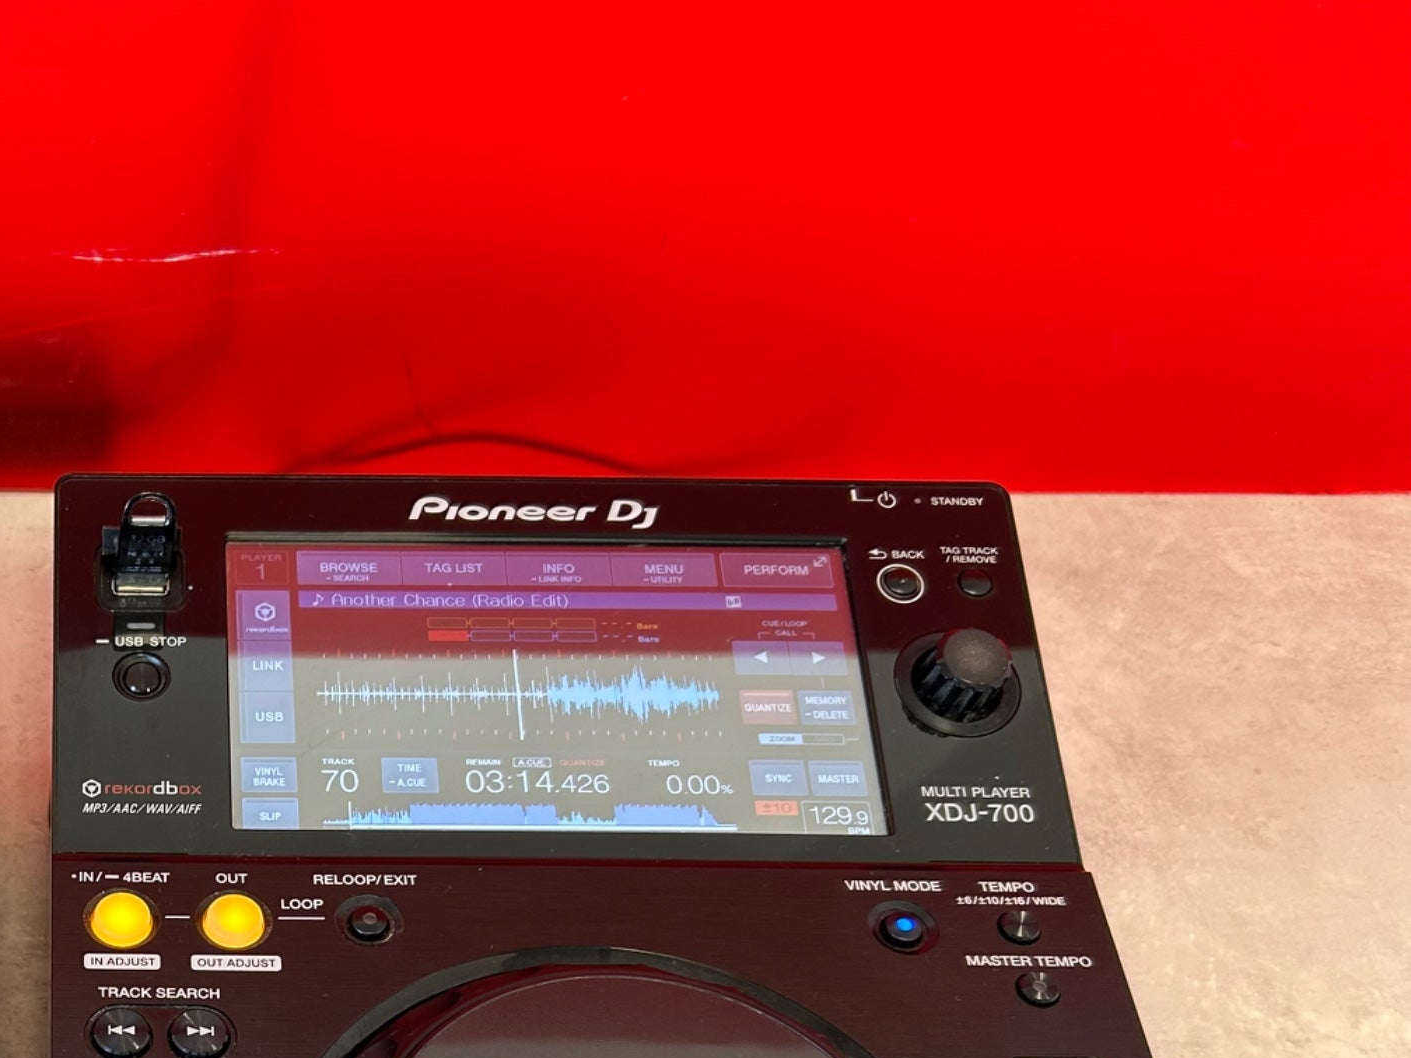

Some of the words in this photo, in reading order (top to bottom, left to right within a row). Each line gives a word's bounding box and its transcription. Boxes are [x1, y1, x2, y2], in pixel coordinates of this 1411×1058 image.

[930, 497, 983, 506] STANDBY
[408, 496, 597, 521] Pioneer
[891, 550, 925, 560] BACK
[940, 547, 960, 555] TAG
[963, 547, 998, 555] TRACK
[256, 563, 264, 580] 1
[320, 562, 378, 573] BROWSE
[424, 563, 451, 574] TAG
[456, 563, 483, 574] LIST
[542, 563, 575, 574] INFO
[644, 564, 684, 574] MENU
[744, 565, 809, 576] PERFORM
[331, 593, 398, 607] Another
[404, 593, 466, 607] Chance
[472, 593, 525, 608] (Radio
[531, 594, 569, 609] Edit)
[114, 637, 144, 647] USB
[149, 637, 187, 647] STOP
[252, 660, 284, 671] LINK
[804, 697, 846, 705] MEMORY
[744, 704, 793, 713] QUANTIZE
[255, 712, 284, 722] USB
[813, 710, 849, 719] DELETE
[465, 758, 501, 766] REMAIN
[254, 767, 283, 777] VINYL
[397, 764, 421, 773] TIME
[253, 777, 286, 787] BRAKE
[321, 770, 359, 792] 70
[465, 770, 610, 794] 03:14.426
[764, 774, 793, 783] SYNC
[818, 774, 859, 784] MASTER
[104, 780, 202, 795] rekordbox
[921, 786, 967, 798] MULTI
[972, 787, 1031, 799] PLAYER
[259, 812, 282, 821] SLIP
[809, 806, 869, 826] 129.9
[926, 803, 1035, 823] XDJ-700
[123, 872, 170, 883] 4BEAT
[215, 873, 248, 884] OUT
[844, 880, 891, 891] VINYL
[894, 880, 942, 892] MODE
[978, 881, 1035, 893] TEMPO
[280, 899, 324, 910] LOOP
[90, 957, 104, 967] IN
[107, 957, 156, 967] ADJUST
[197, 958, 223, 968] OUT
[226, 958, 276, 968] ADJUST
[965, 955, 1033, 967] MASTER
[1034, 955, 1093, 968] TEMPO
[98, 987, 152, 998] TRACK
[156, 987, 221, 999] SEARCH
